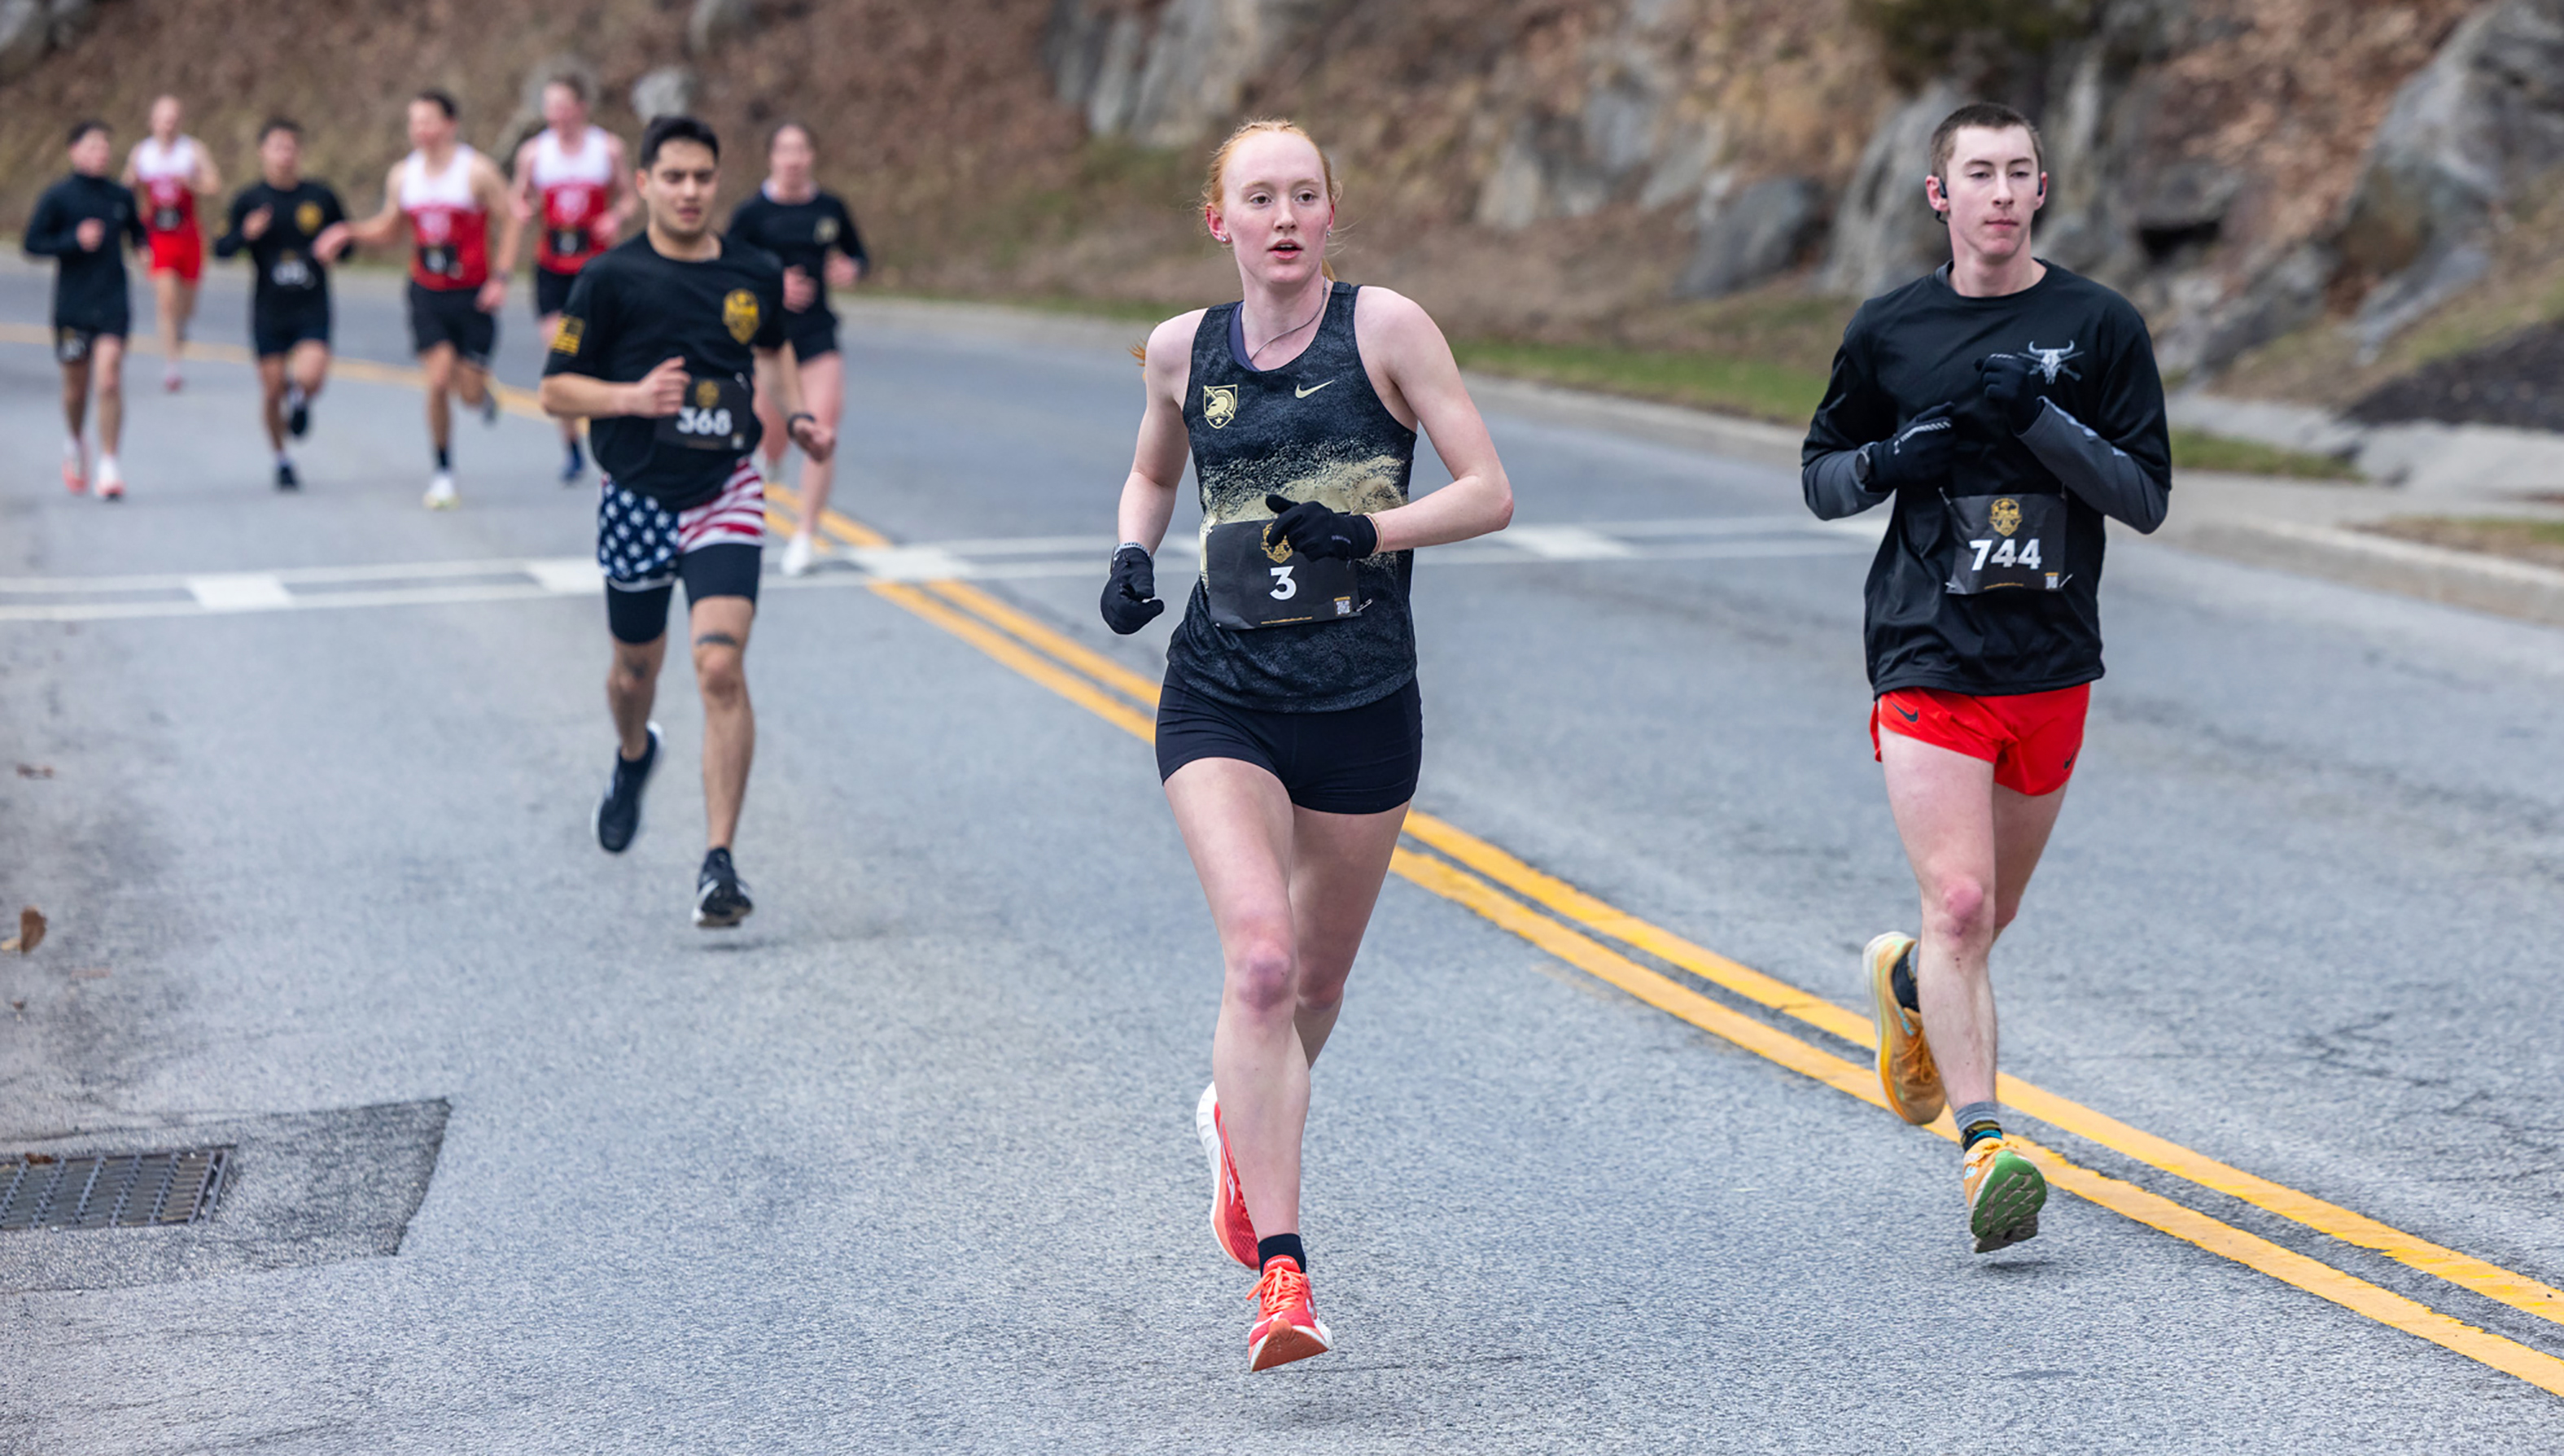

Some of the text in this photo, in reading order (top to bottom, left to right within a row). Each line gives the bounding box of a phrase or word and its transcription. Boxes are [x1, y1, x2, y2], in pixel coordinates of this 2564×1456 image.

[676, 407, 733, 436] 368
[1969, 539, 2041, 571] 744
[1270, 566, 1297, 601] 3
